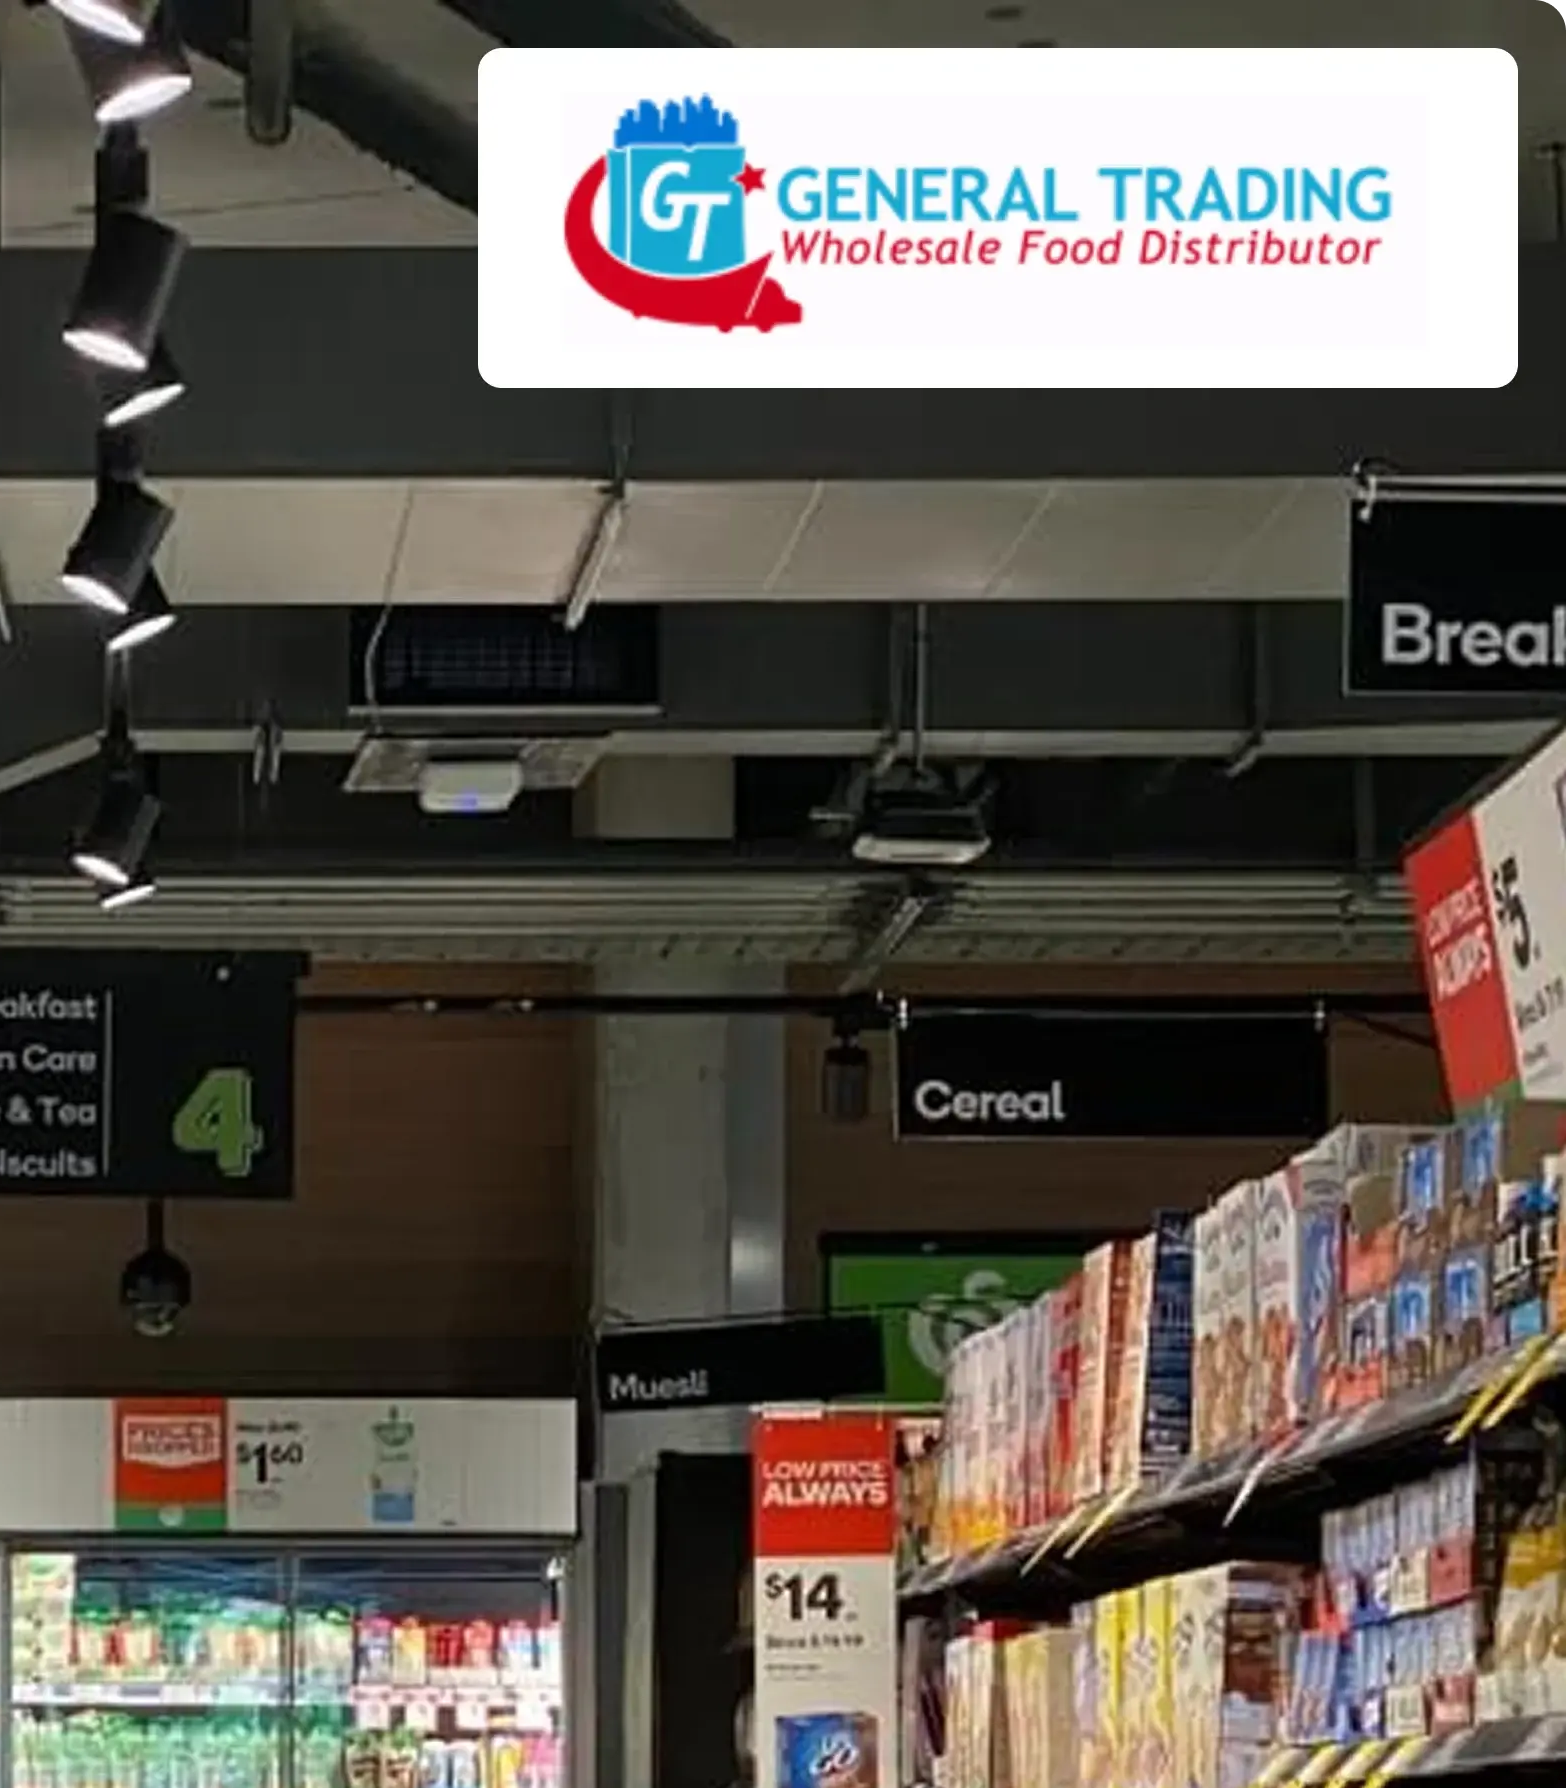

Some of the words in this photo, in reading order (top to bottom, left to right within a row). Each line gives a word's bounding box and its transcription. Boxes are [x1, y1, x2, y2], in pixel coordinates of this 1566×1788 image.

[22, 1044, 97, 1072] Care
[6, 1096, 32, 1123] &
[37, 1096, 97, 1124] Tea
[914, 1079, 1067, 1120] Cereal
[172, 1068, 264, 1177] 4
[609, 1369, 708, 1400] Muesli
[762, 1461, 817, 1480] LOW
[818, 1461, 886, 1480] PRICE
[761, 1481, 887, 1506] ALWAYS
[765, 1572, 843, 1622] $14
